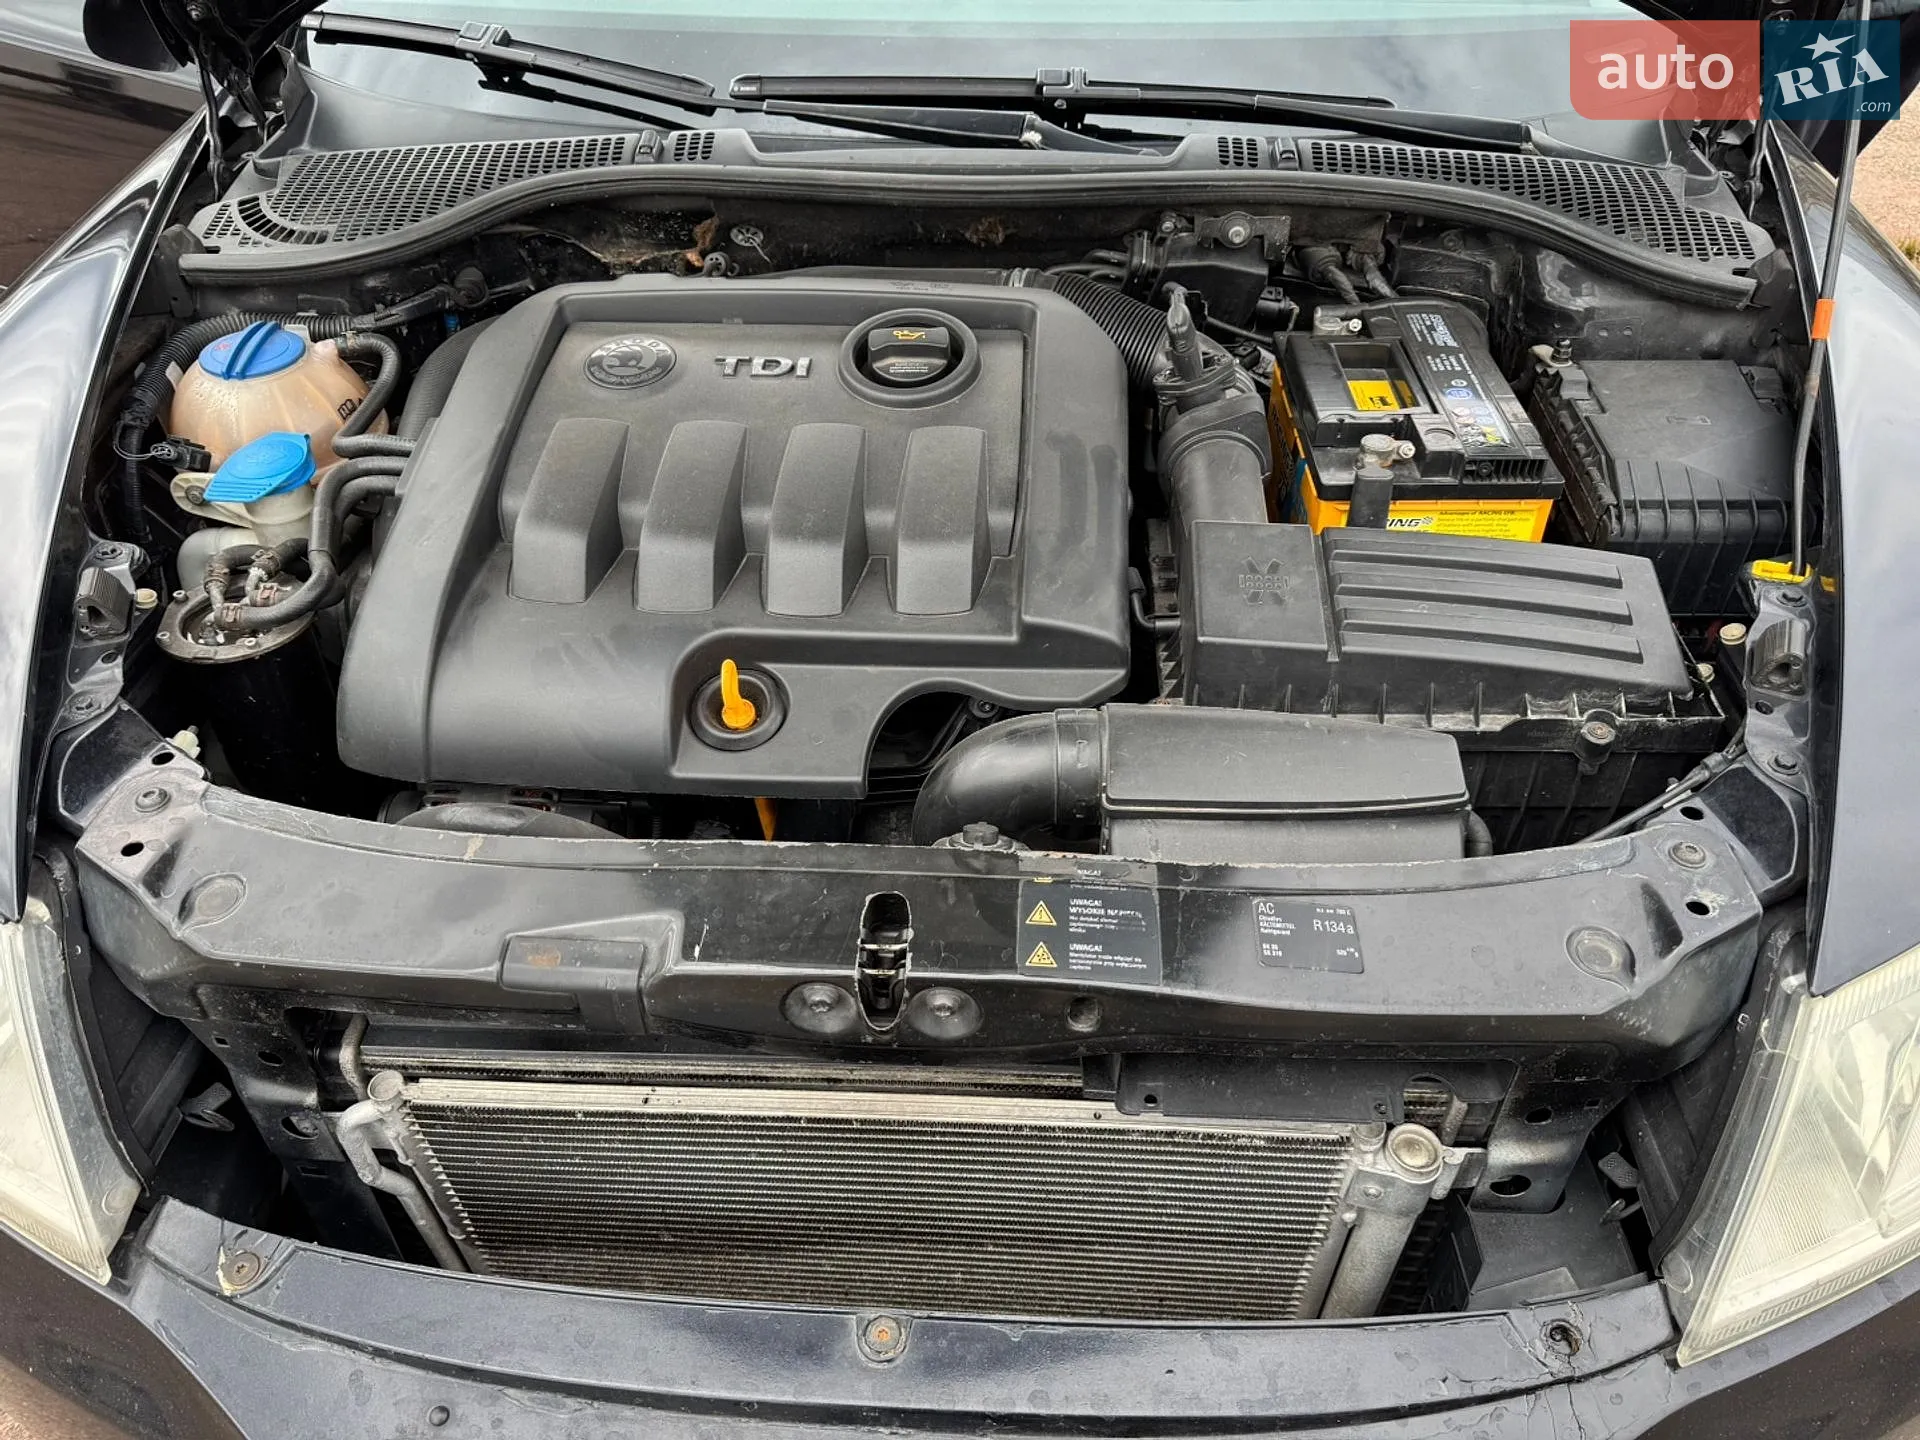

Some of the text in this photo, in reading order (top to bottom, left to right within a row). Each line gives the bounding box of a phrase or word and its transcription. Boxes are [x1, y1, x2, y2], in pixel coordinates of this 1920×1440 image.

[715, 356, 813, 378] TDI
[1386, 518, 1421, 528] ING
[1069, 898, 1103, 906] UWAGA!
[1258, 902, 1275, 914] AC
[1069, 943, 1103, 952] UWAGA!
